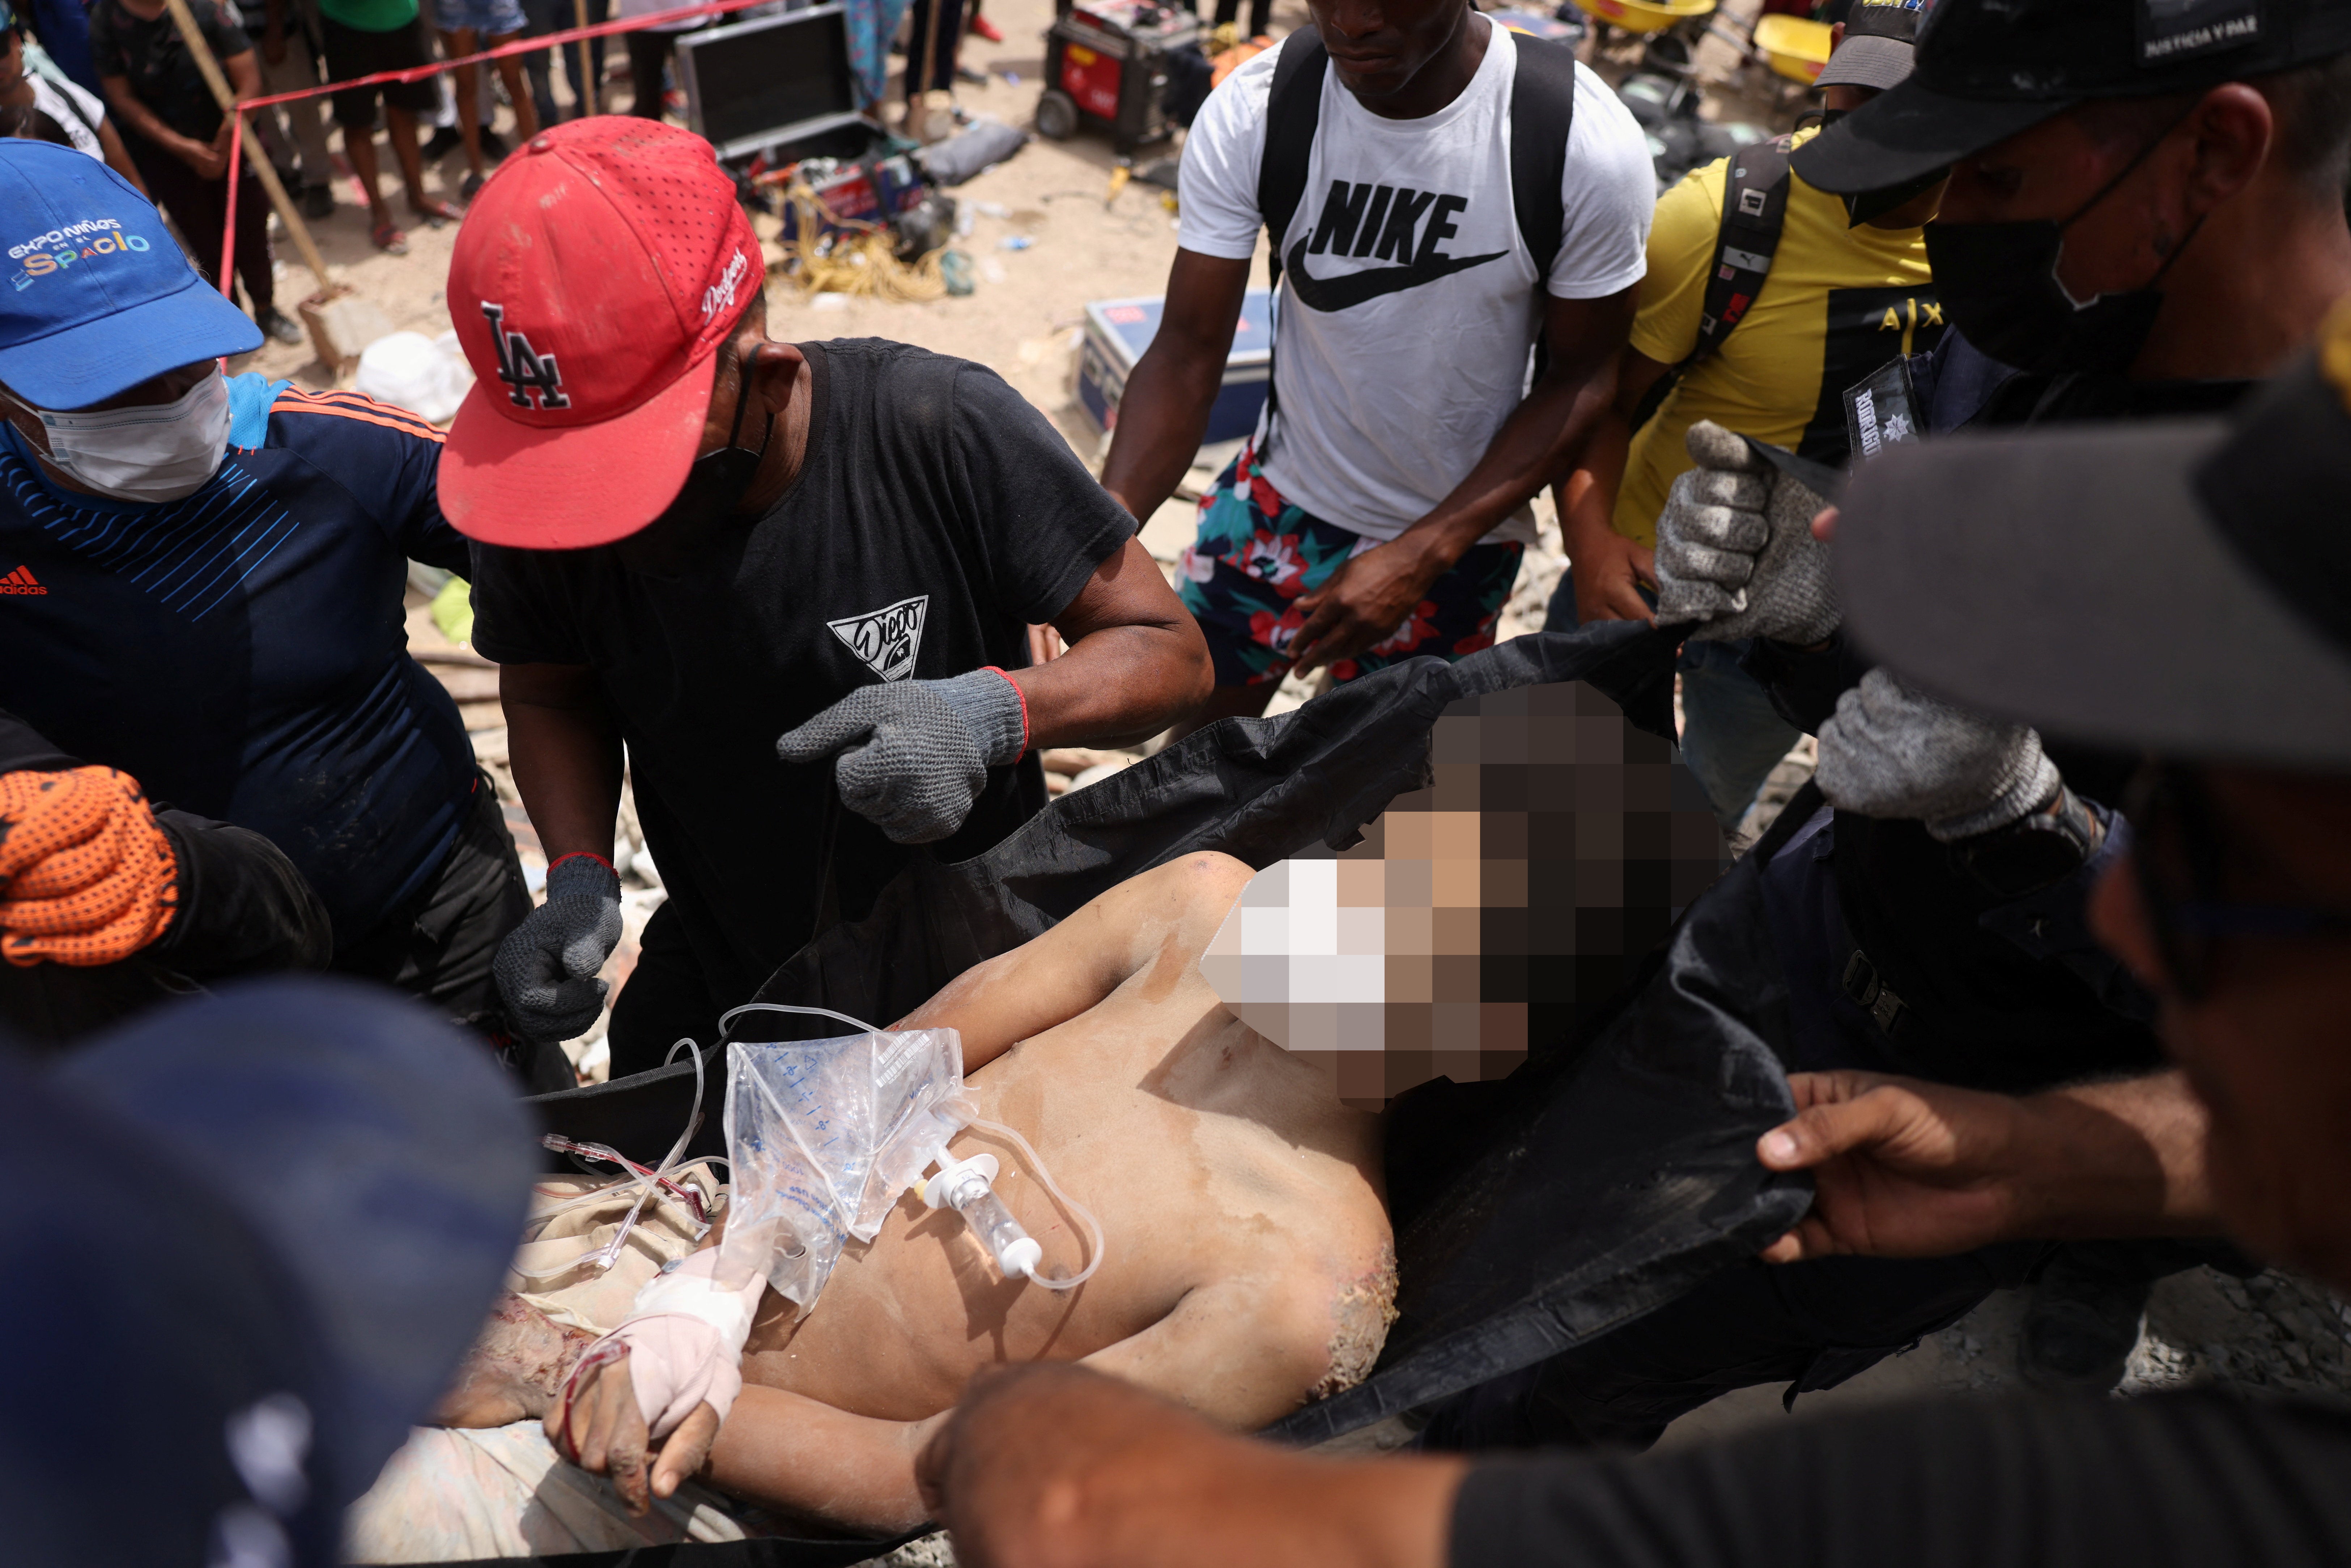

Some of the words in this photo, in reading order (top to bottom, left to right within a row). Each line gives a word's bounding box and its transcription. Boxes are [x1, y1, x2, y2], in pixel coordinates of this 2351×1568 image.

[2212, 22, 2225, 41] Y
[52, 242, 69, 251] EN
[1308, 179, 1468, 267] NIKE
[702, 246, 748, 326] Dodgers
[480, 300, 571, 410] LA
[854, 602, 921, 663] Diego
